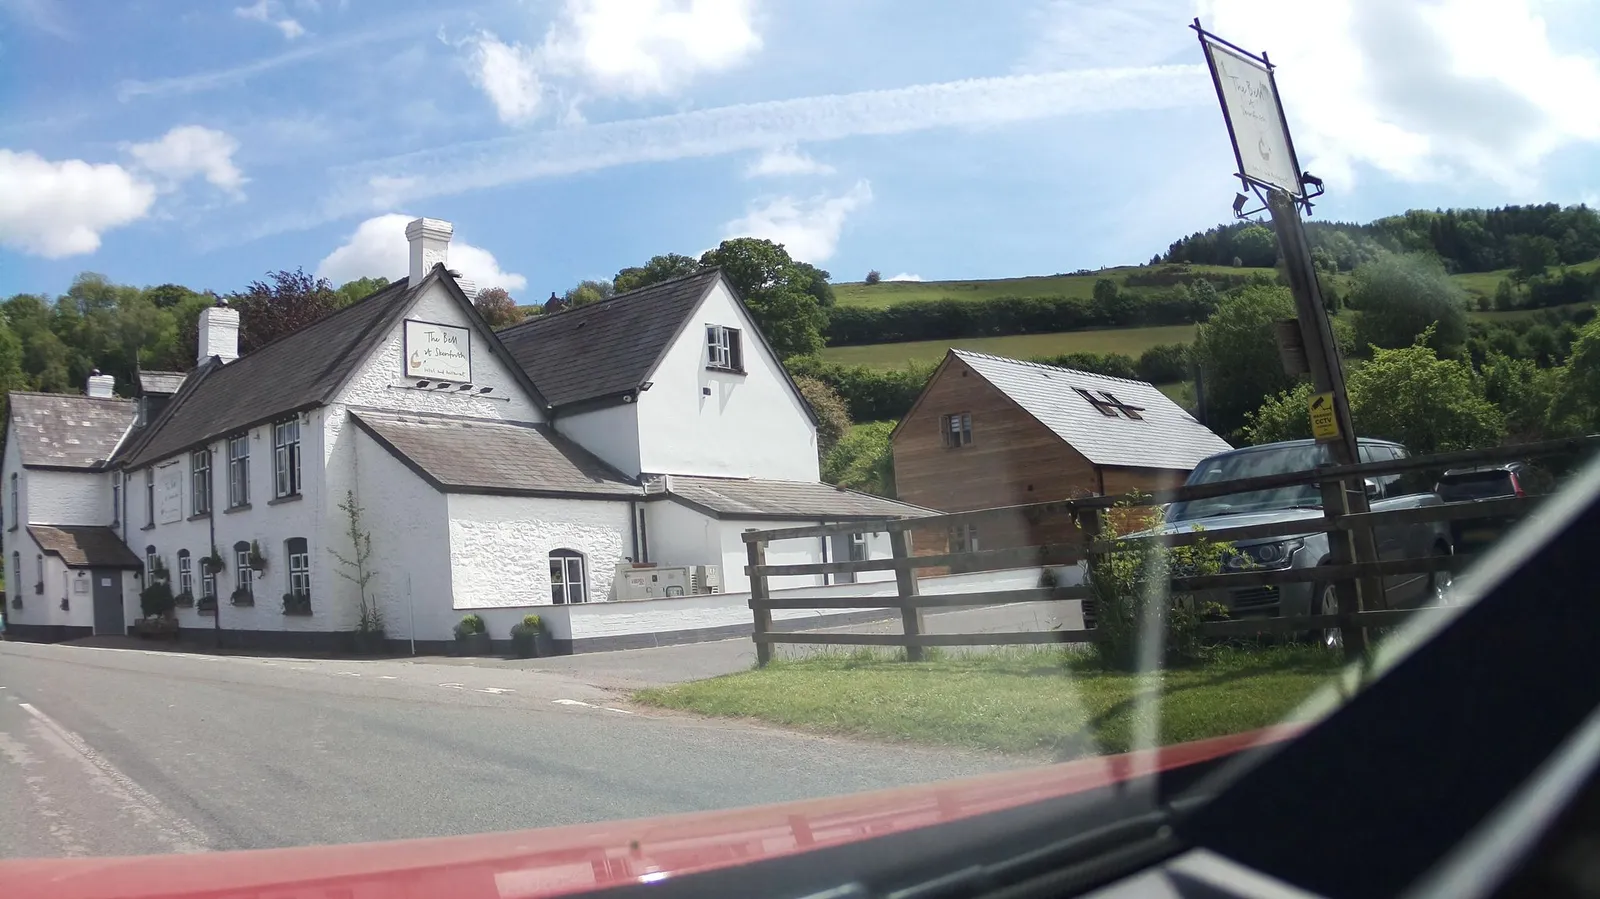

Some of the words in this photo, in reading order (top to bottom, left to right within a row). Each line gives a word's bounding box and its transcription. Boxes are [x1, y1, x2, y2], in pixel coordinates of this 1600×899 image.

[1228, 75, 1247, 94] The
[1245, 80, 1265, 100] Bell
[424, 331, 441, 343] The
[443, 332, 458, 344] Bell
[424, 348, 432, 357] at
[1315, 417, 1332, 425] CCTV
